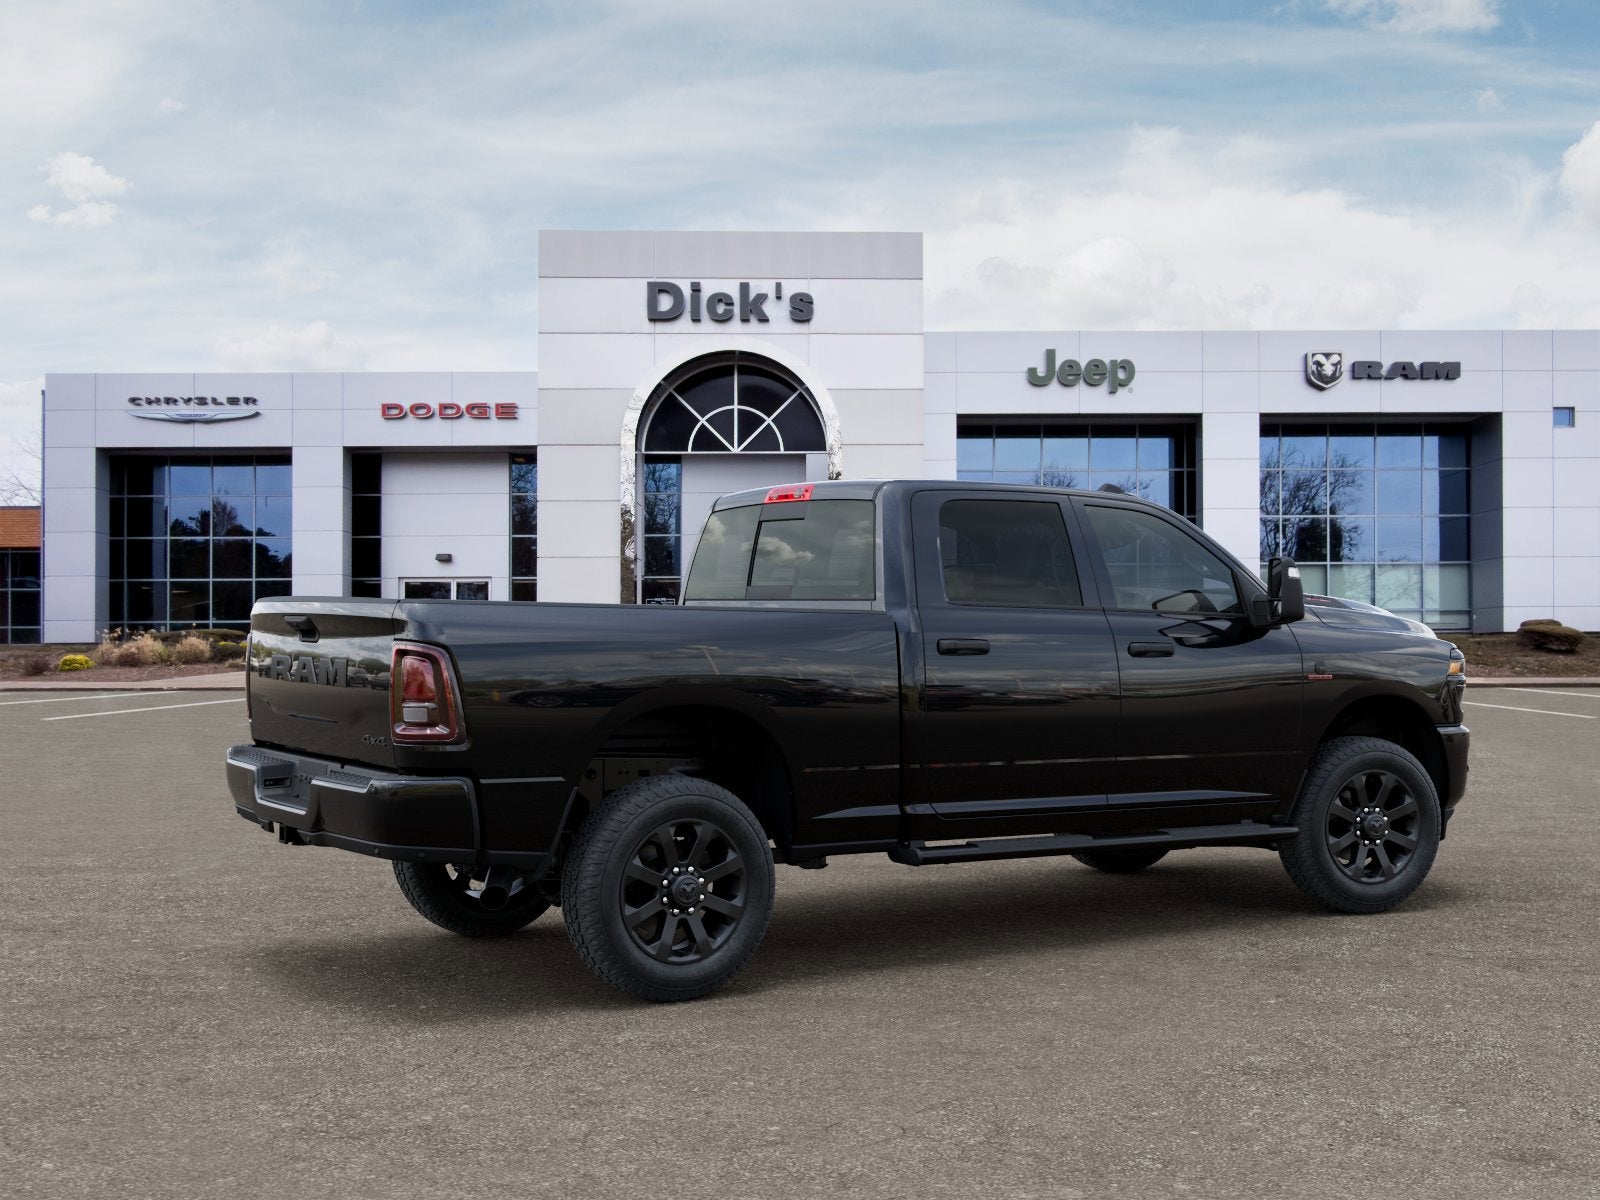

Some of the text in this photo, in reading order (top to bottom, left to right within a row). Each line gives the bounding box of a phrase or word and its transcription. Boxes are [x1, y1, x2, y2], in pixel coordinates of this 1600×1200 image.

[647, 281, 814, 322] Dick's
[1027, 348, 1136, 394] Jeep
[1352, 361, 1461, 380] RAM
[127, 396, 258, 406] CHRYSLER
[381, 403, 518, 419] DODGE
[271, 654, 348, 687] RAM
